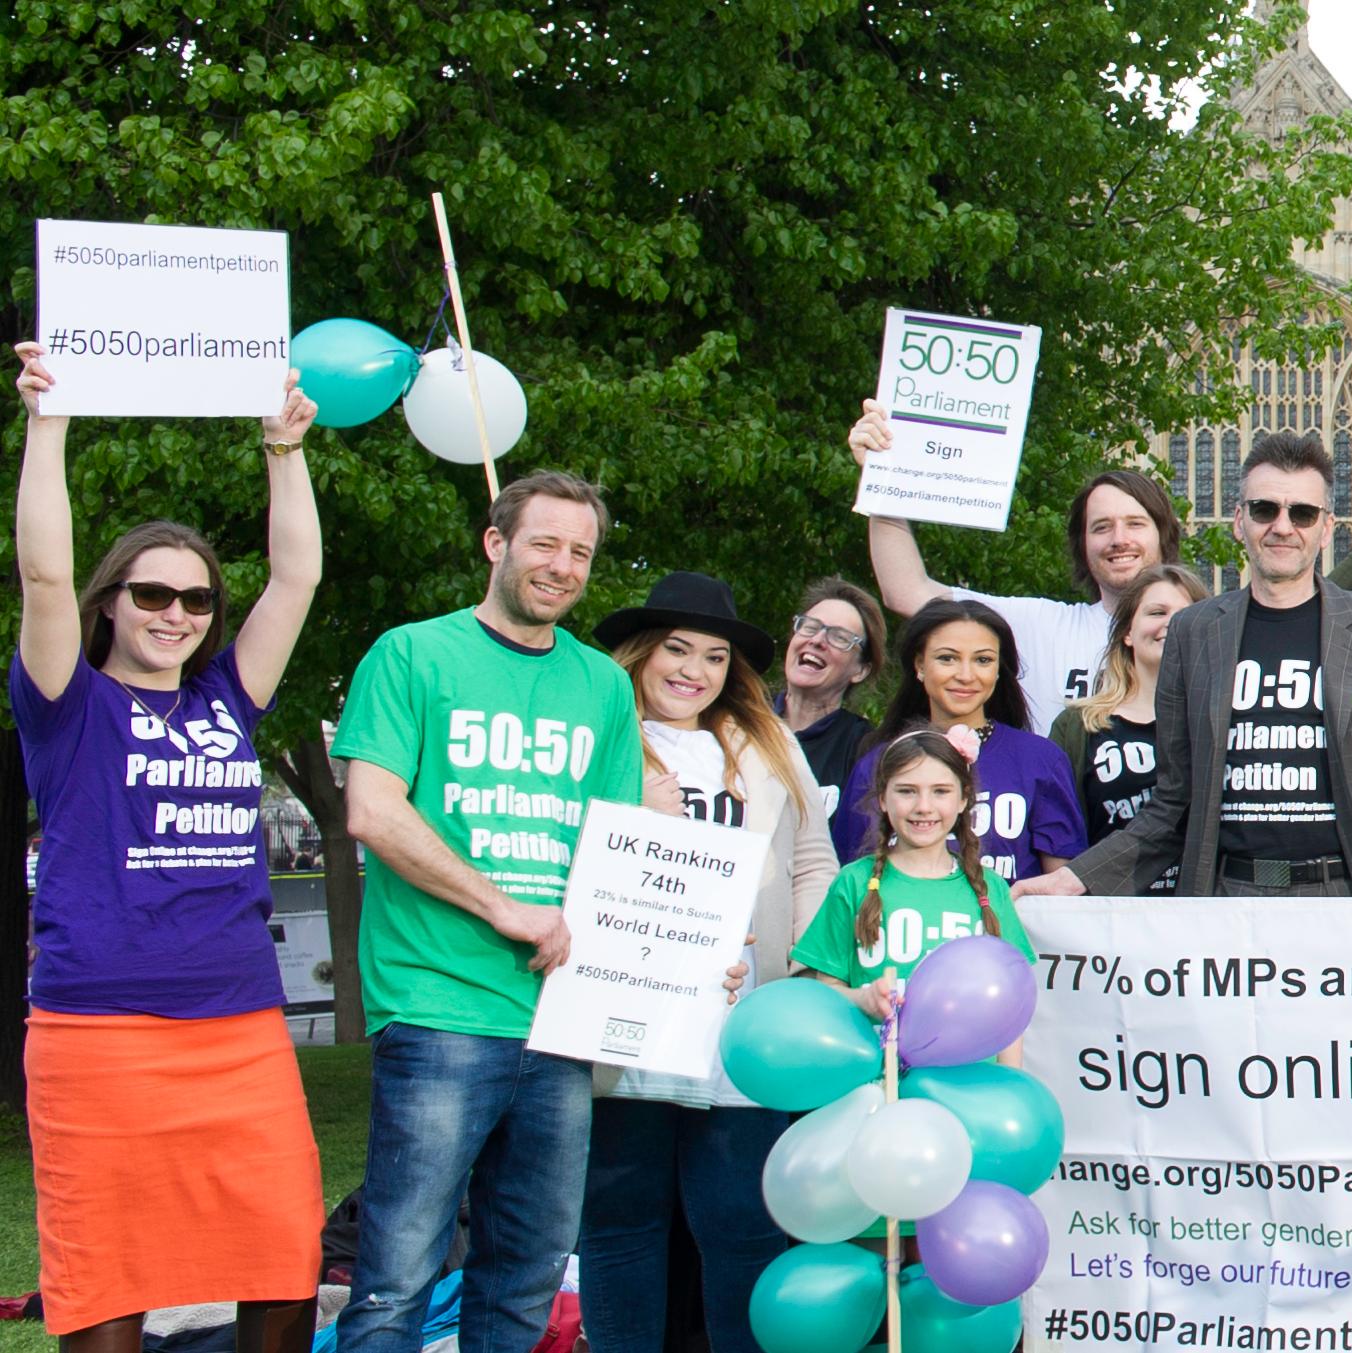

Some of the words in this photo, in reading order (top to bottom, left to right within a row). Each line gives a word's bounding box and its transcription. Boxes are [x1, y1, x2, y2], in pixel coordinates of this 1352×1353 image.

[53, 246, 279, 274] #5050parliamentpetition
[49, 329, 286, 362] #5050parliament
[899, 331, 1019, 384] 50:50
[893, 376, 1011, 420] Parliament
[925, 441, 963, 459] Sign
[866, 484, 1002, 510] #5050parliamentpetition
[448, 710, 594, 782] 50:50
[126, 754, 262, 787] Parliame
[444, 783, 582, 827] Parliamen
[471, 828, 570, 867] Petition
[607, 833, 640, 855] UK
[646, 842, 736, 878] Ranking
[640, 871, 686, 895] 74th
[593, 889, 615, 902] 23%
[619, 894, 628, 905] is
[632, 896, 669, 912] similar
[672, 904, 684, 915] to
[687, 907, 722, 922] Sudan
[596, 911, 649, 935] World
[656, 923, 720, 948] Leader
[640, 947, 651, 961] ?
[576, 964, 699, 997] #5050Parliament
[1038, 954, 1133, 995] 77%
[1145, 958, 1190, 997] of
[1203, 958, 1306, 998] MPs
[1078, 1035, 1211, 1109] sign
[1069, 1211, 1120, 1236] Ask
[1128, 1212, 1161, 1238] for
[1171, 1217, 1251, 1242] better
[1070, 1253, 1133, 1279] Let's
[1144, 1255, 1211, 1287] forge
[1220, 1263, 1266, 1284] our
[1269, 1260, 1351, 1289] future
